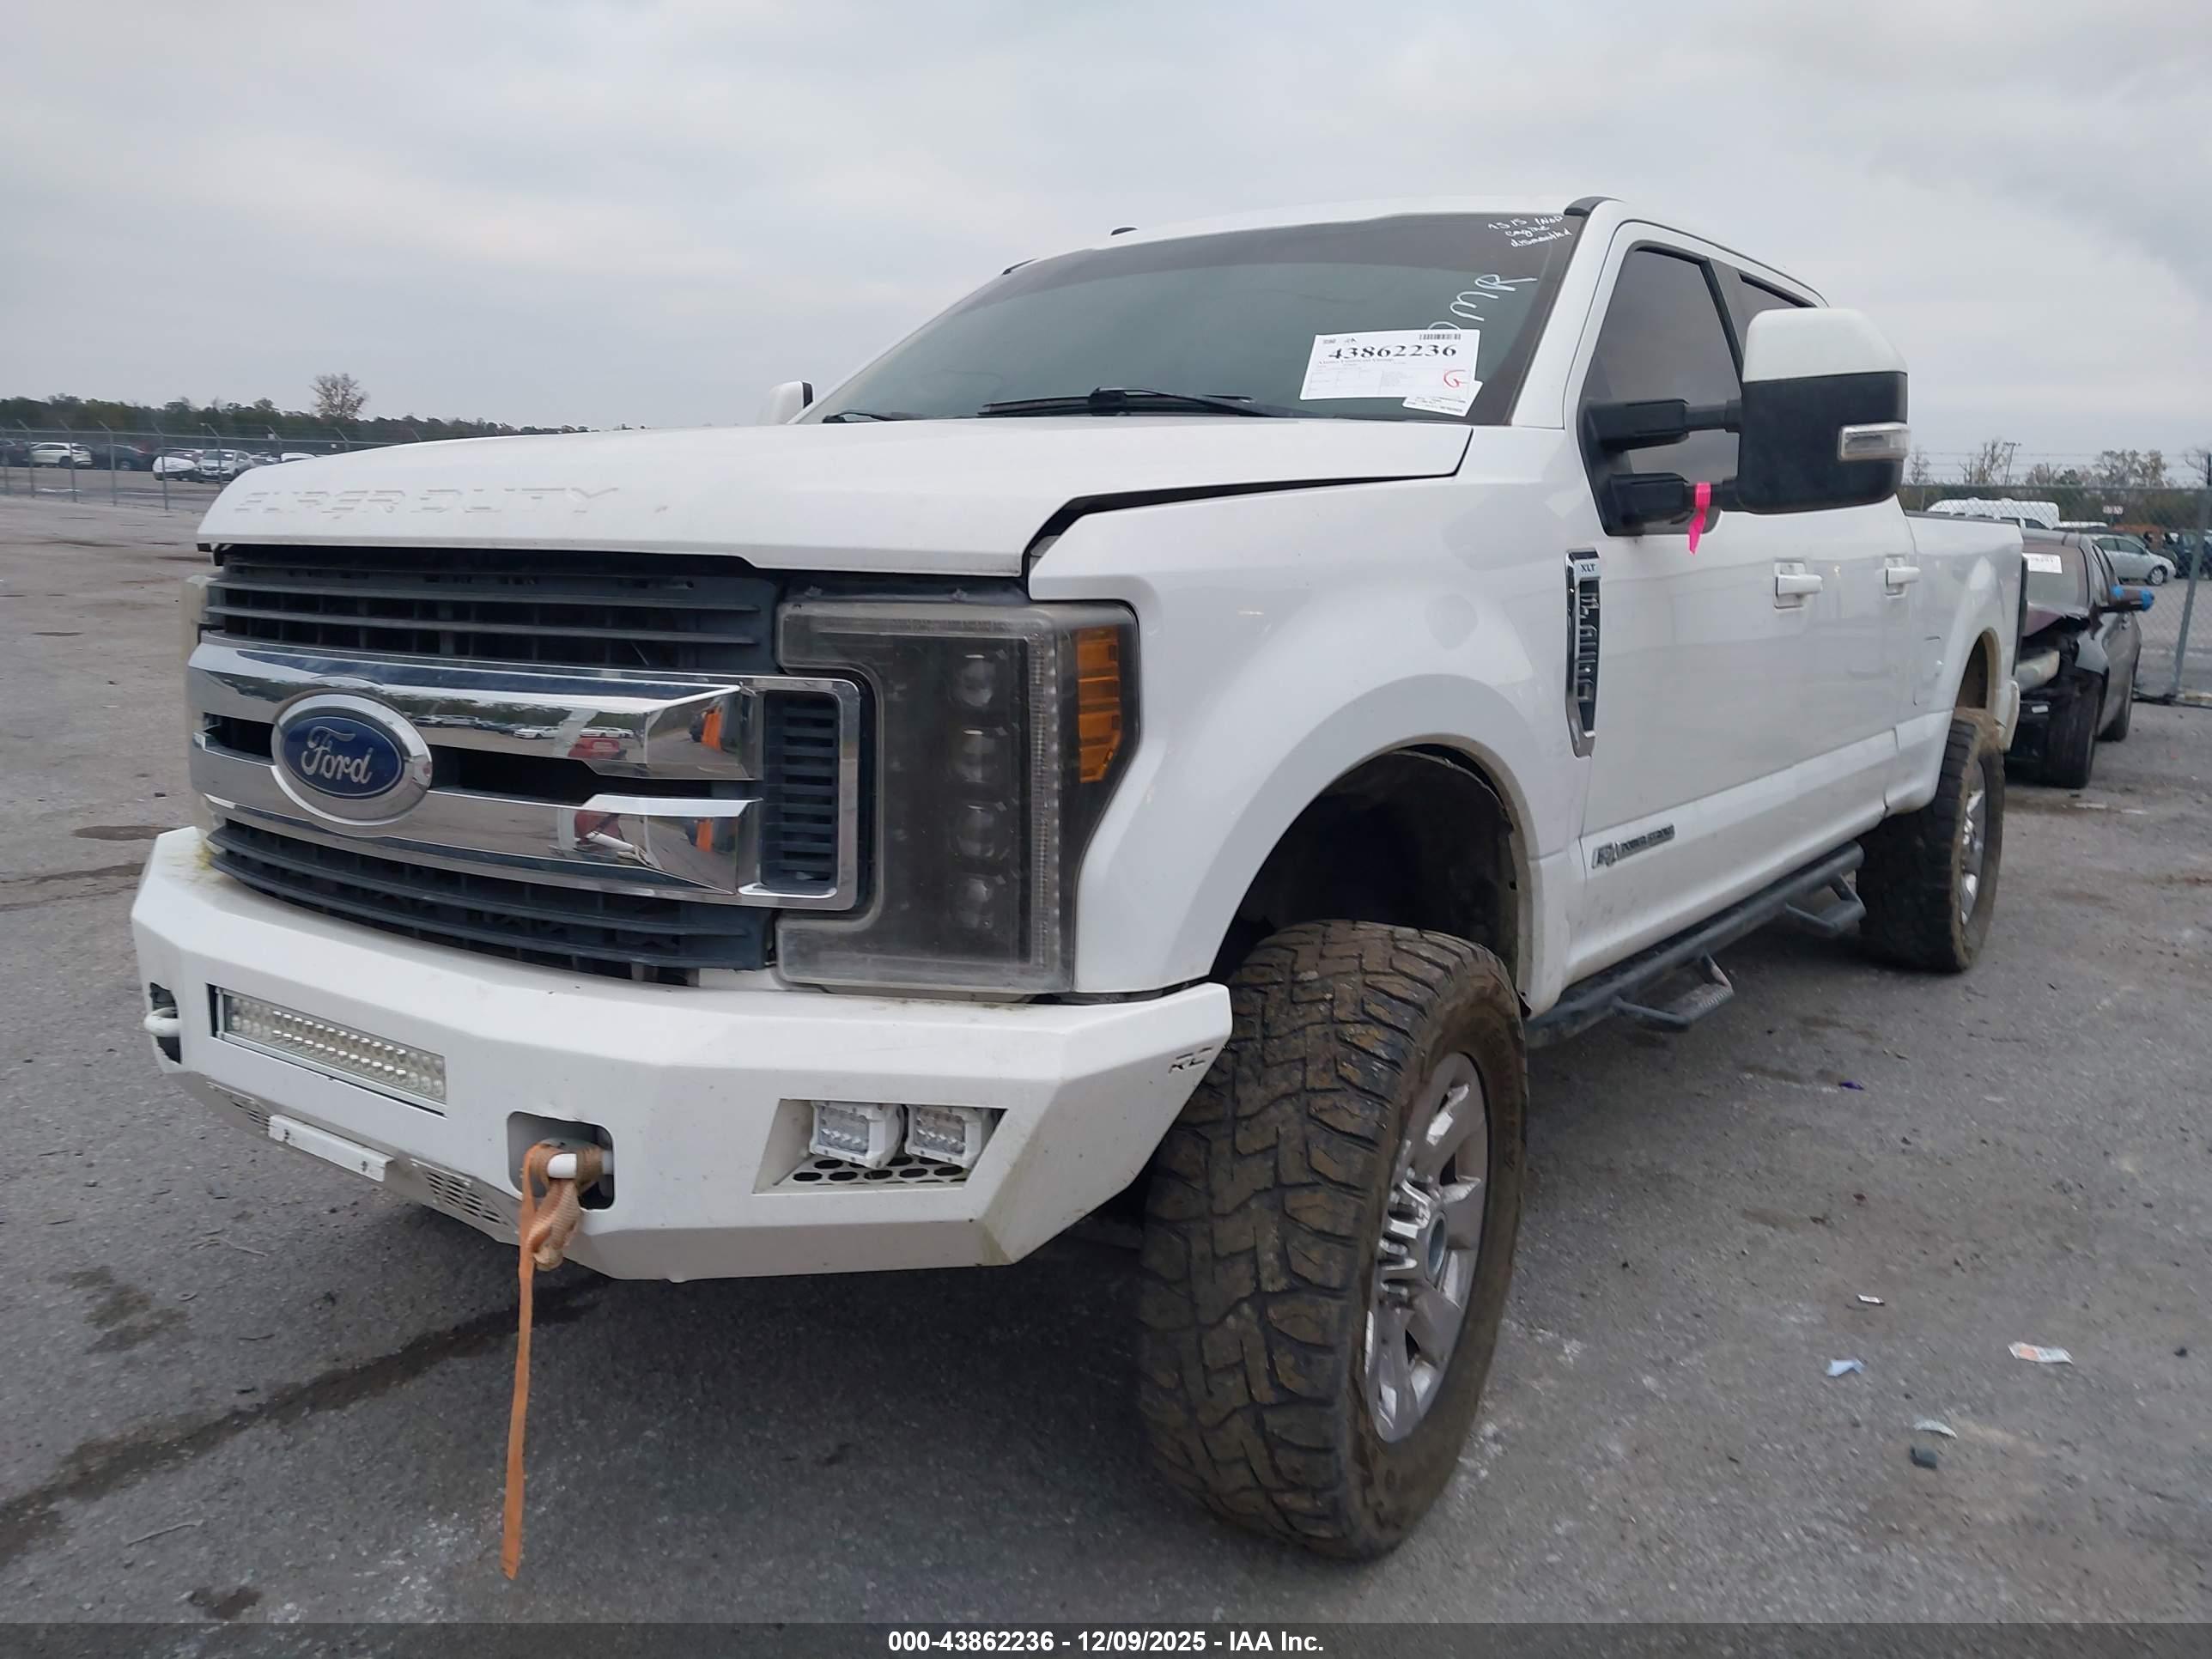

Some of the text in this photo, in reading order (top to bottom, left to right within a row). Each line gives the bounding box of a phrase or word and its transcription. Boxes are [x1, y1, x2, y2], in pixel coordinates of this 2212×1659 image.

[1328, 343, 1457, 360] 43862236
[1580, 562, 1595, 573] XLT
[301, 726, 374, 785] Ford
